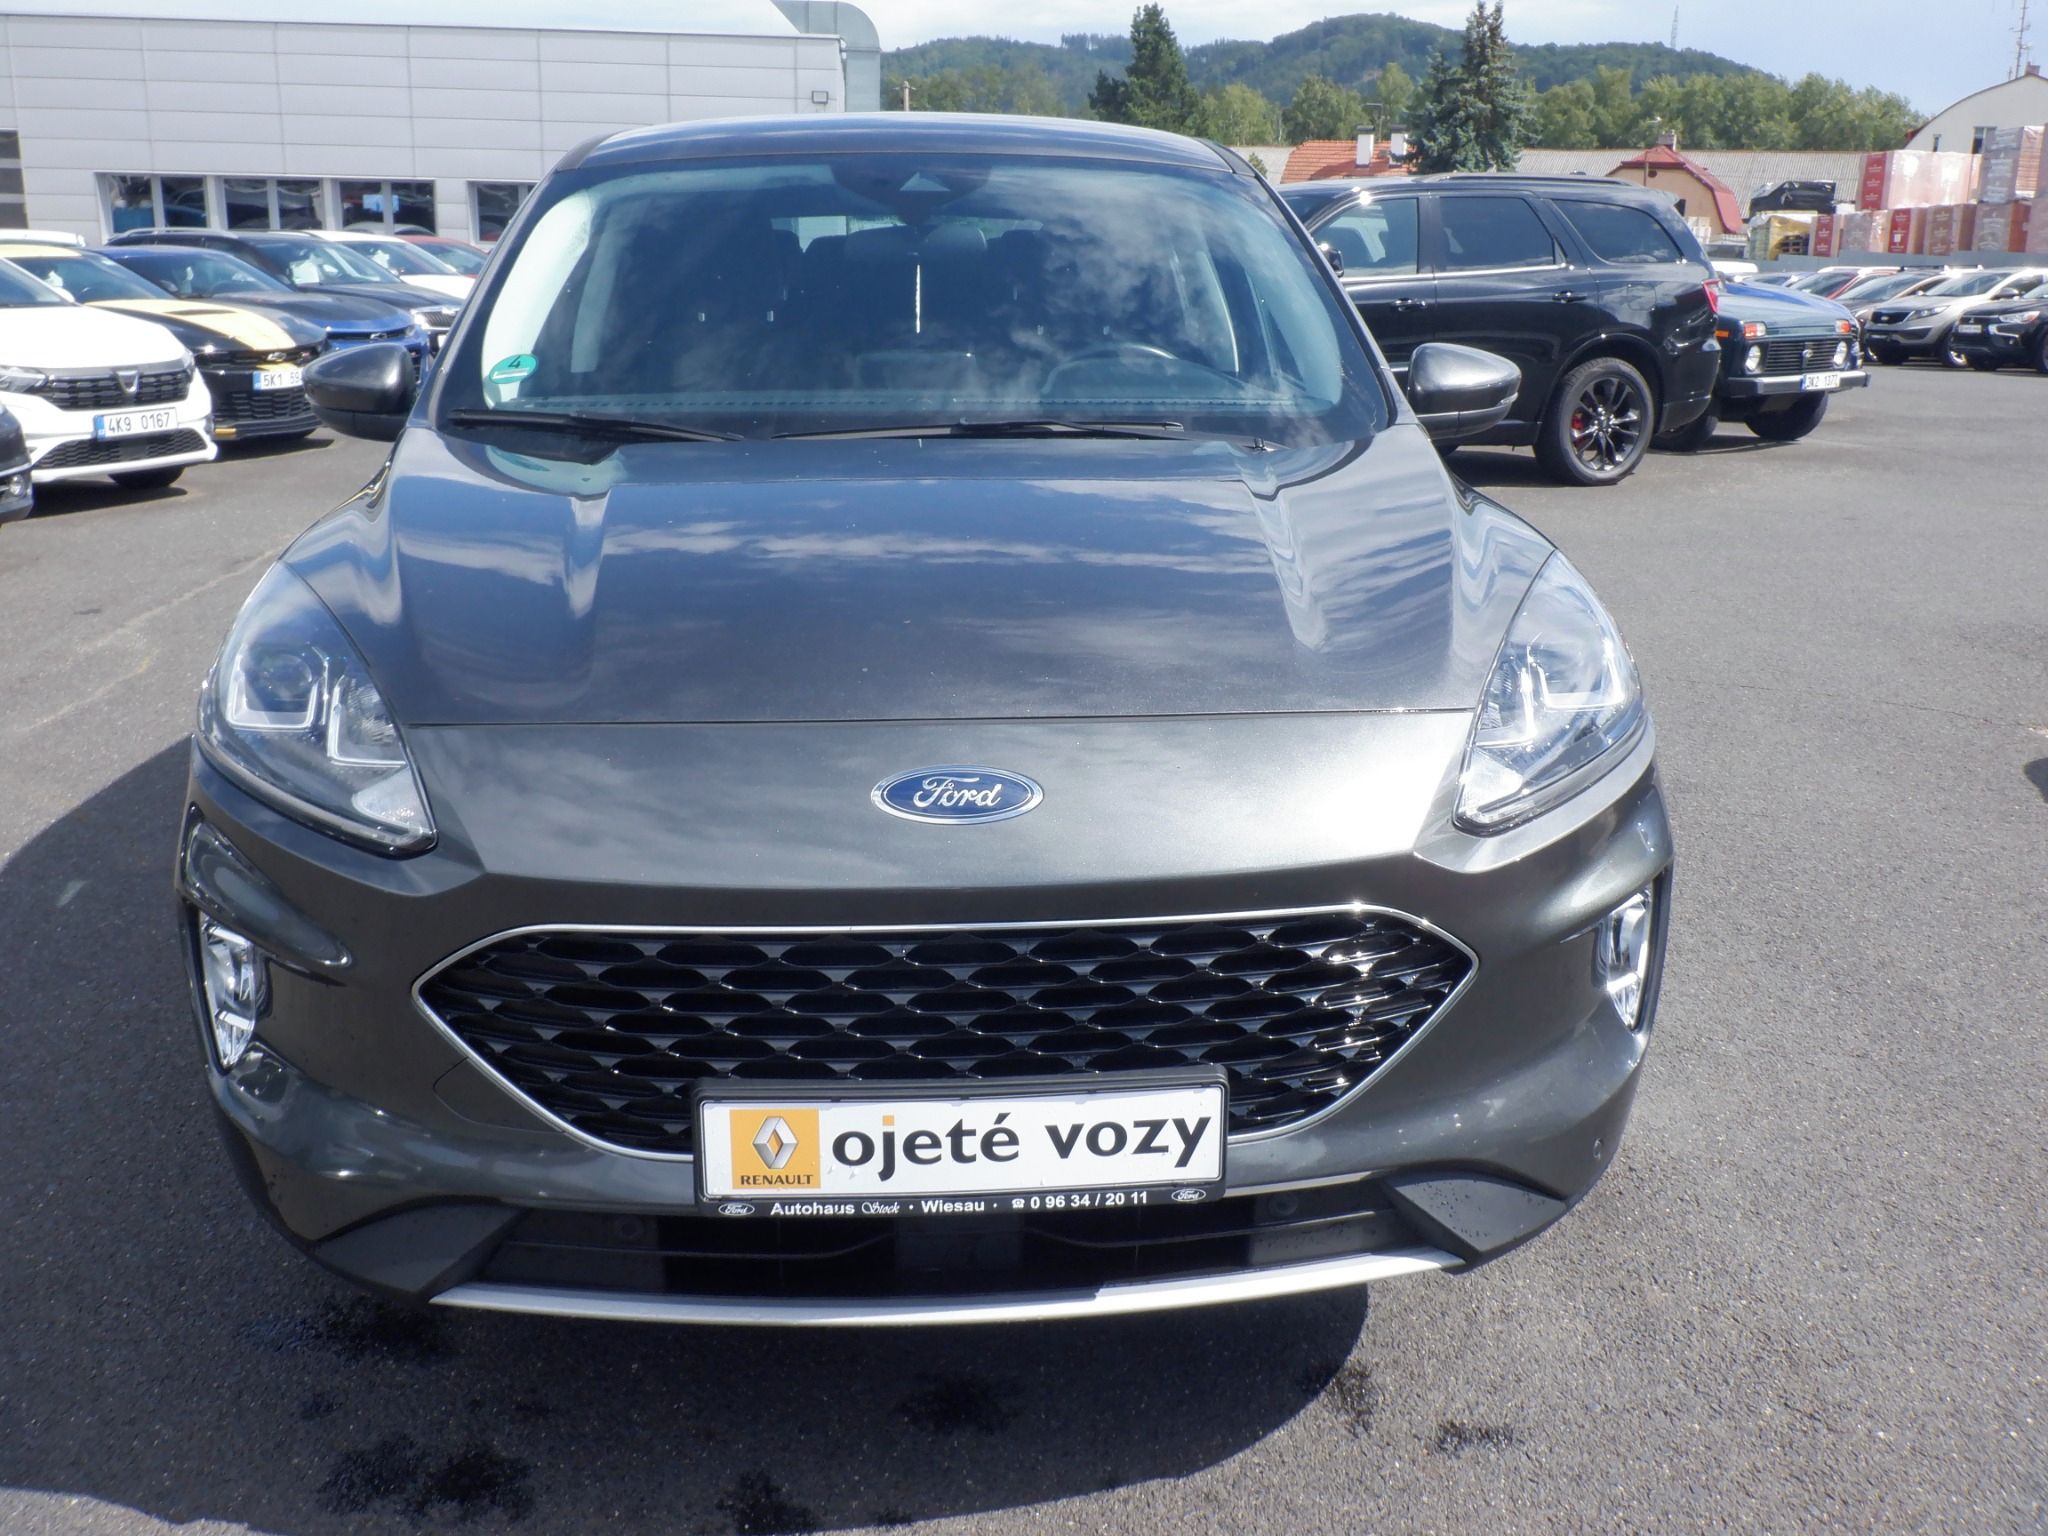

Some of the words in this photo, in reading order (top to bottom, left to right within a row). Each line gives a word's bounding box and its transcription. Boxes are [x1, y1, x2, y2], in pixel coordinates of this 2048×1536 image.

[263, 373, 283, 387] 5K1
[108, 416, 132, 433] 4K9
[141, 412, 170, 430] 0167
[913, 776, 1003, 808] Ford
[832, 1112, 1020, 1182] ojeté
[1044, 1116, 1212, 1168] vozy
[740, 1174, 814, 1185] RENAULT
[770, 1202, 856, 1216] Autohaus
[921, 1199, 985, 1213] Wiesau
[1030, 1197, 1040, 1209] 0
[1045, 1195, 1066, 1208] 96
[1070, 1194, 1091, 1207] 34
[1105, 1192, 1126, 1206] 20
[1130, 1191, 1148, 1204] 11
